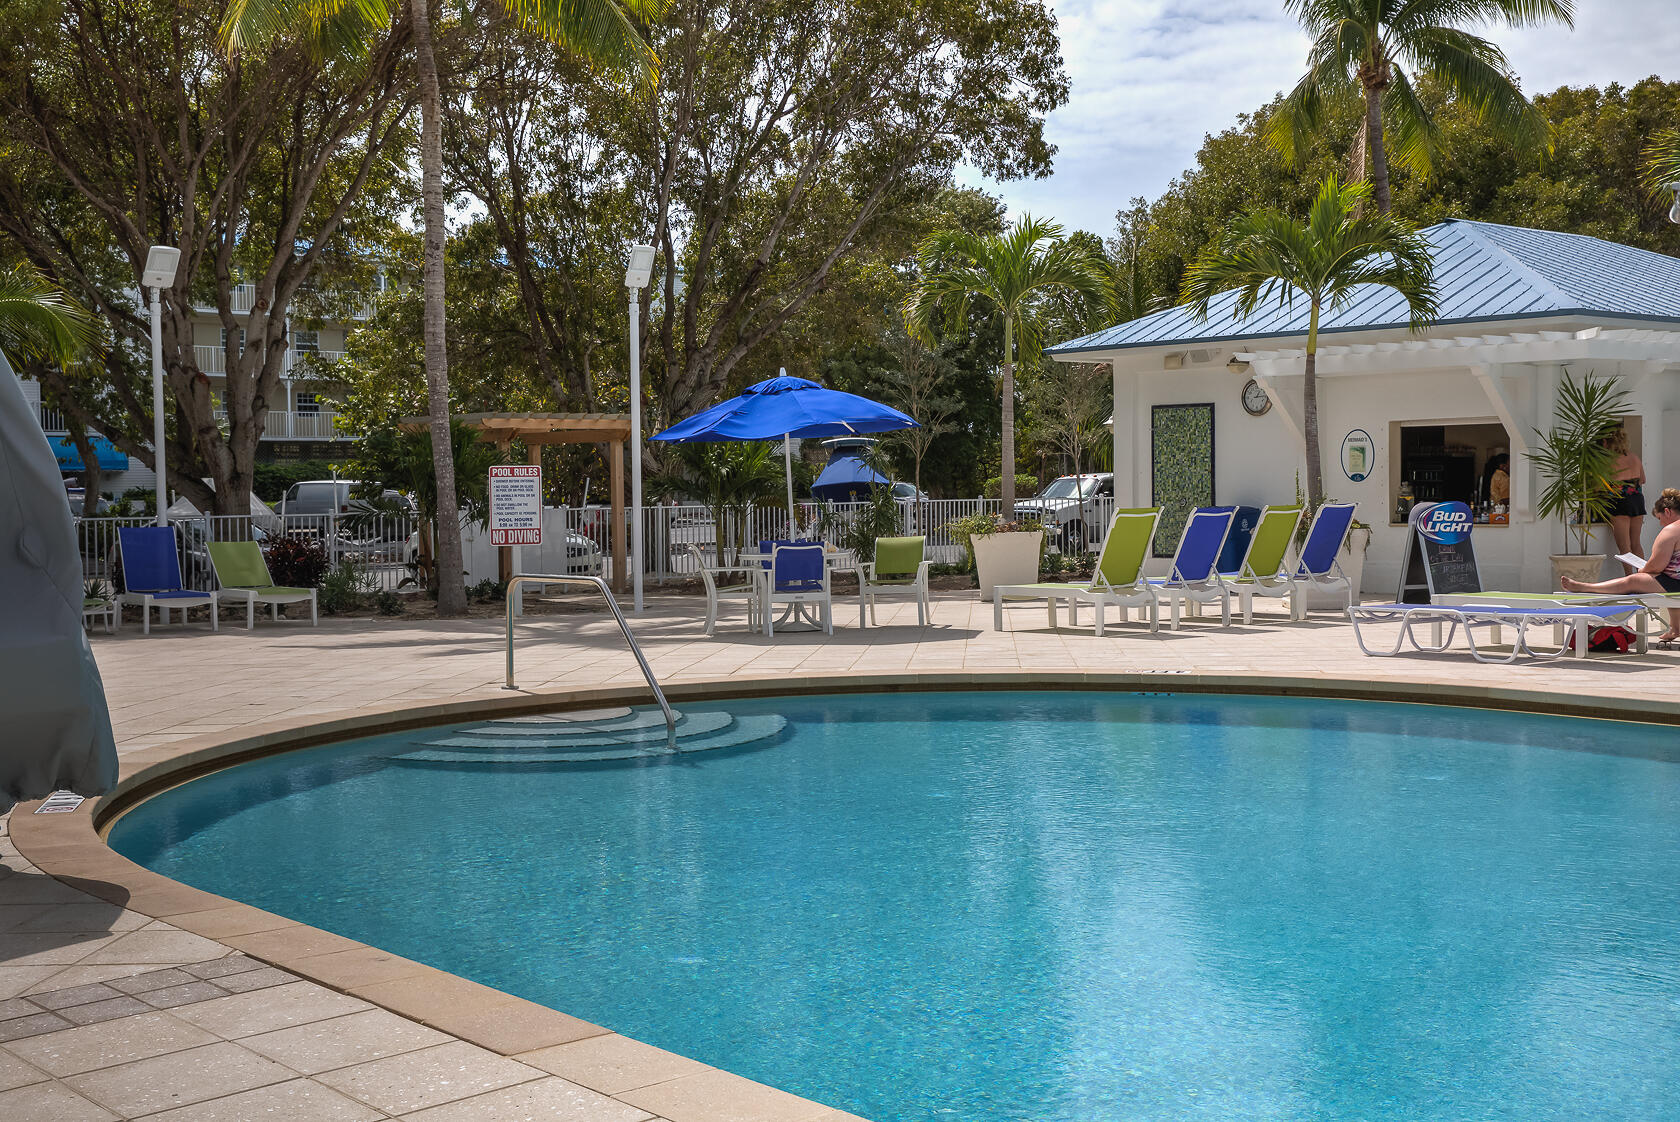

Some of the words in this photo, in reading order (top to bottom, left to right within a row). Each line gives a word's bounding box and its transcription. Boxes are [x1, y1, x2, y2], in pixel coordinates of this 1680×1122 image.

[492, 468, 512, 476] POOL
[514, 468, 538, 476] RULES
[1432, 511, 1467, 521] BUD
[1426, 521, 1472, 532] LIGHT
[493, 530, 505, 544] NO
[508, 530, 539, 543] DIVING
